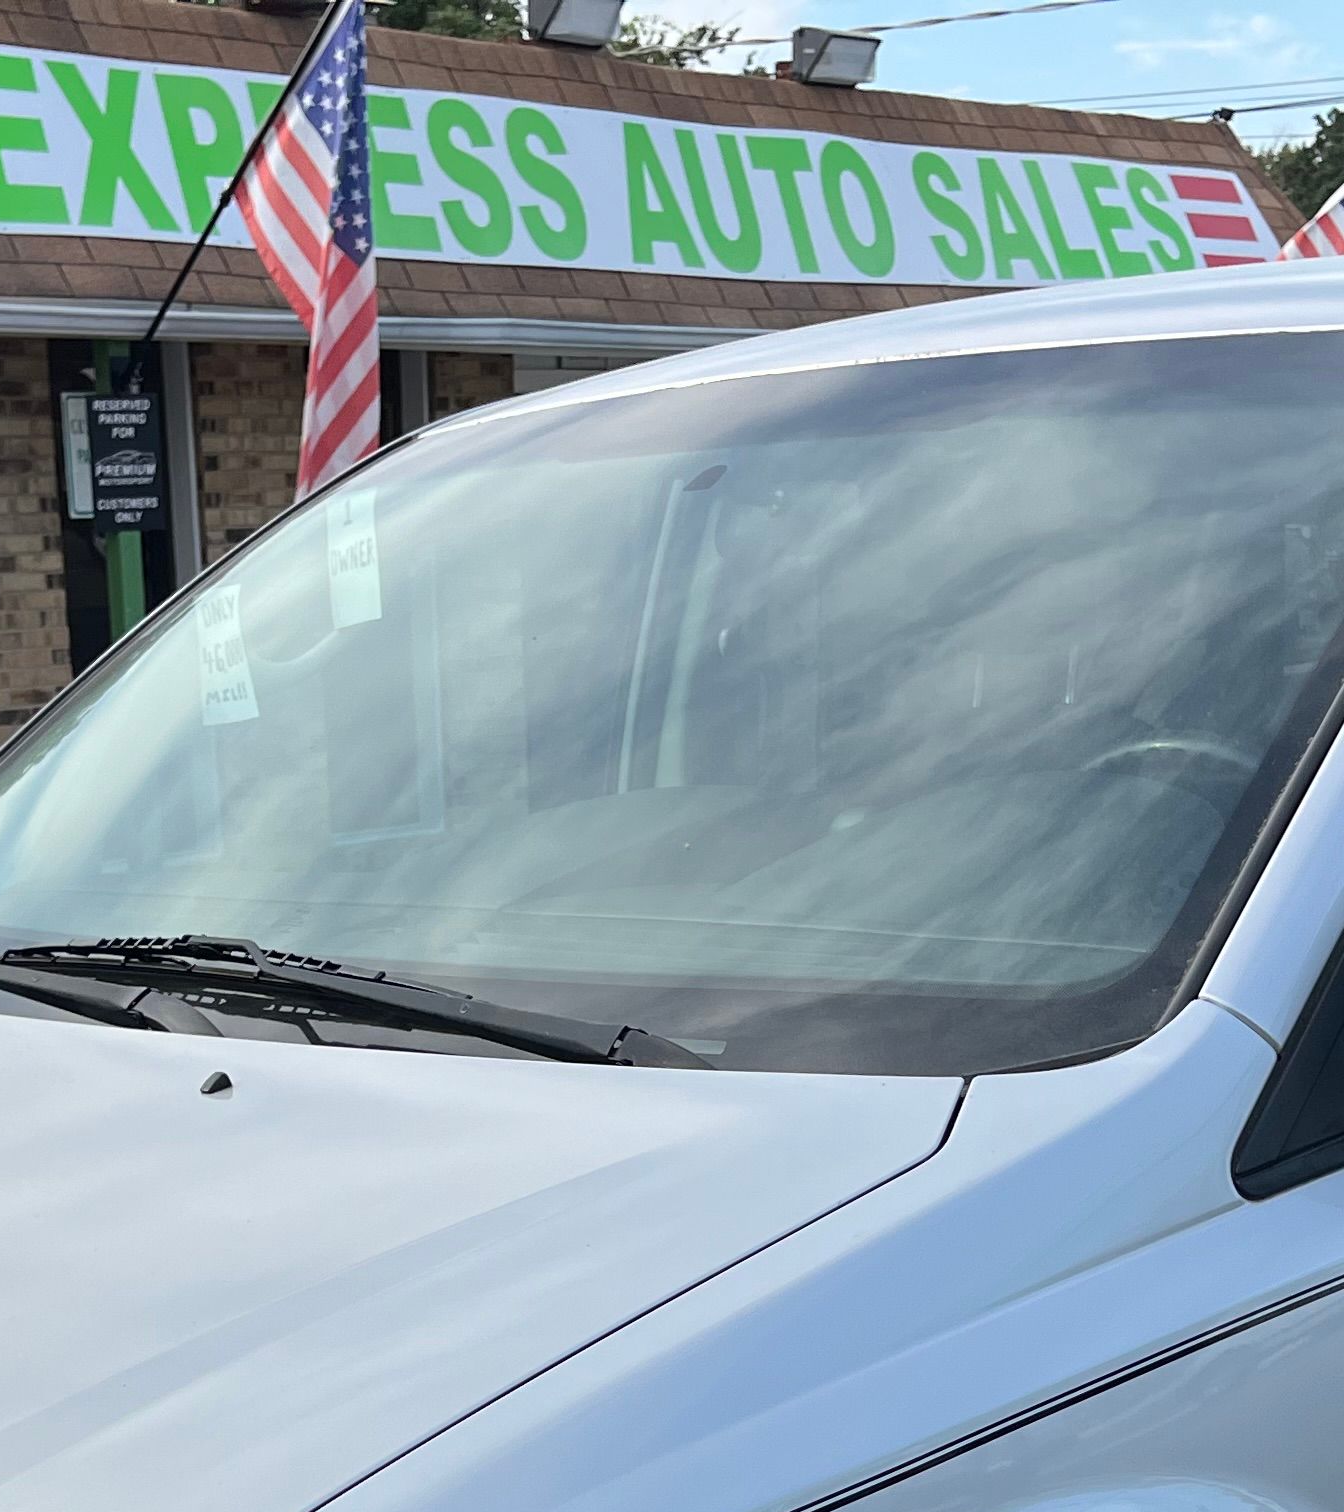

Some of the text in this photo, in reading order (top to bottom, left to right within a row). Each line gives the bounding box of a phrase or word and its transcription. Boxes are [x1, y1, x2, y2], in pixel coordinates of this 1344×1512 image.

[622, 121, 895, 278] AUTO
[912, 151, 1194, 281] SALES
[92, 399, 151, 411] RESERVED
[97, 412, 147, 425] PARKING
[111, 426, 136, 439] FOR
[95, 463, 157, 478] PREMIUM
[96, 496, 159, 511] CUSTOMERS
[114, 511, 143, 523] ONLY
[330, 537, 375, 577] OWNER
[202, 594, 235, 629] ONLY
